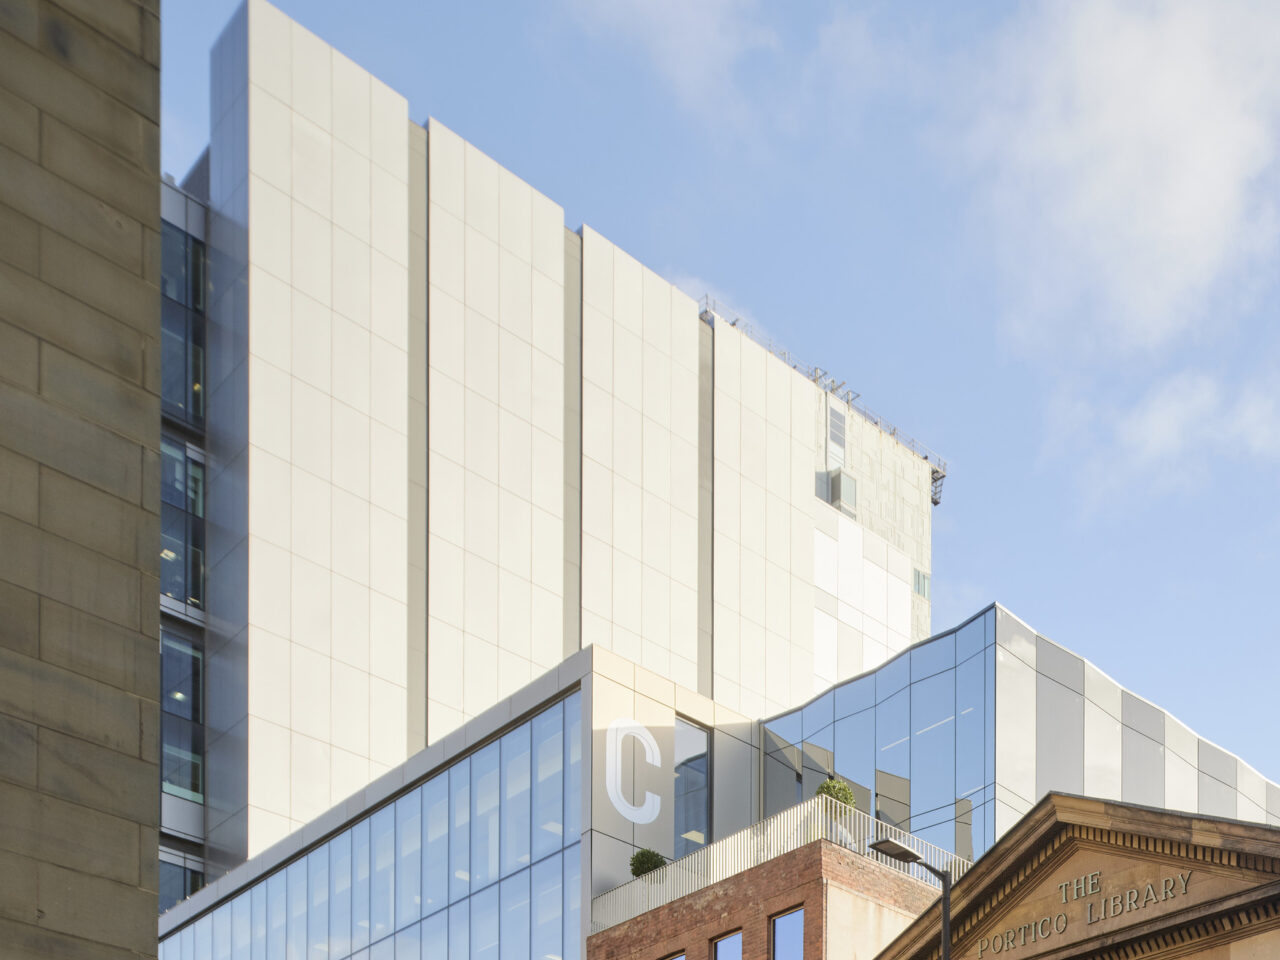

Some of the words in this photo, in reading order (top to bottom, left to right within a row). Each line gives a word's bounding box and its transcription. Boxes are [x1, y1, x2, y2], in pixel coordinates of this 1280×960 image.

[606, 718, 661, 825] C
[977, 913, 1068, 959] PORTICO
[1087, 870, 1192, 925] LIBRARY
[1058, 871, 1101, 904] THE
